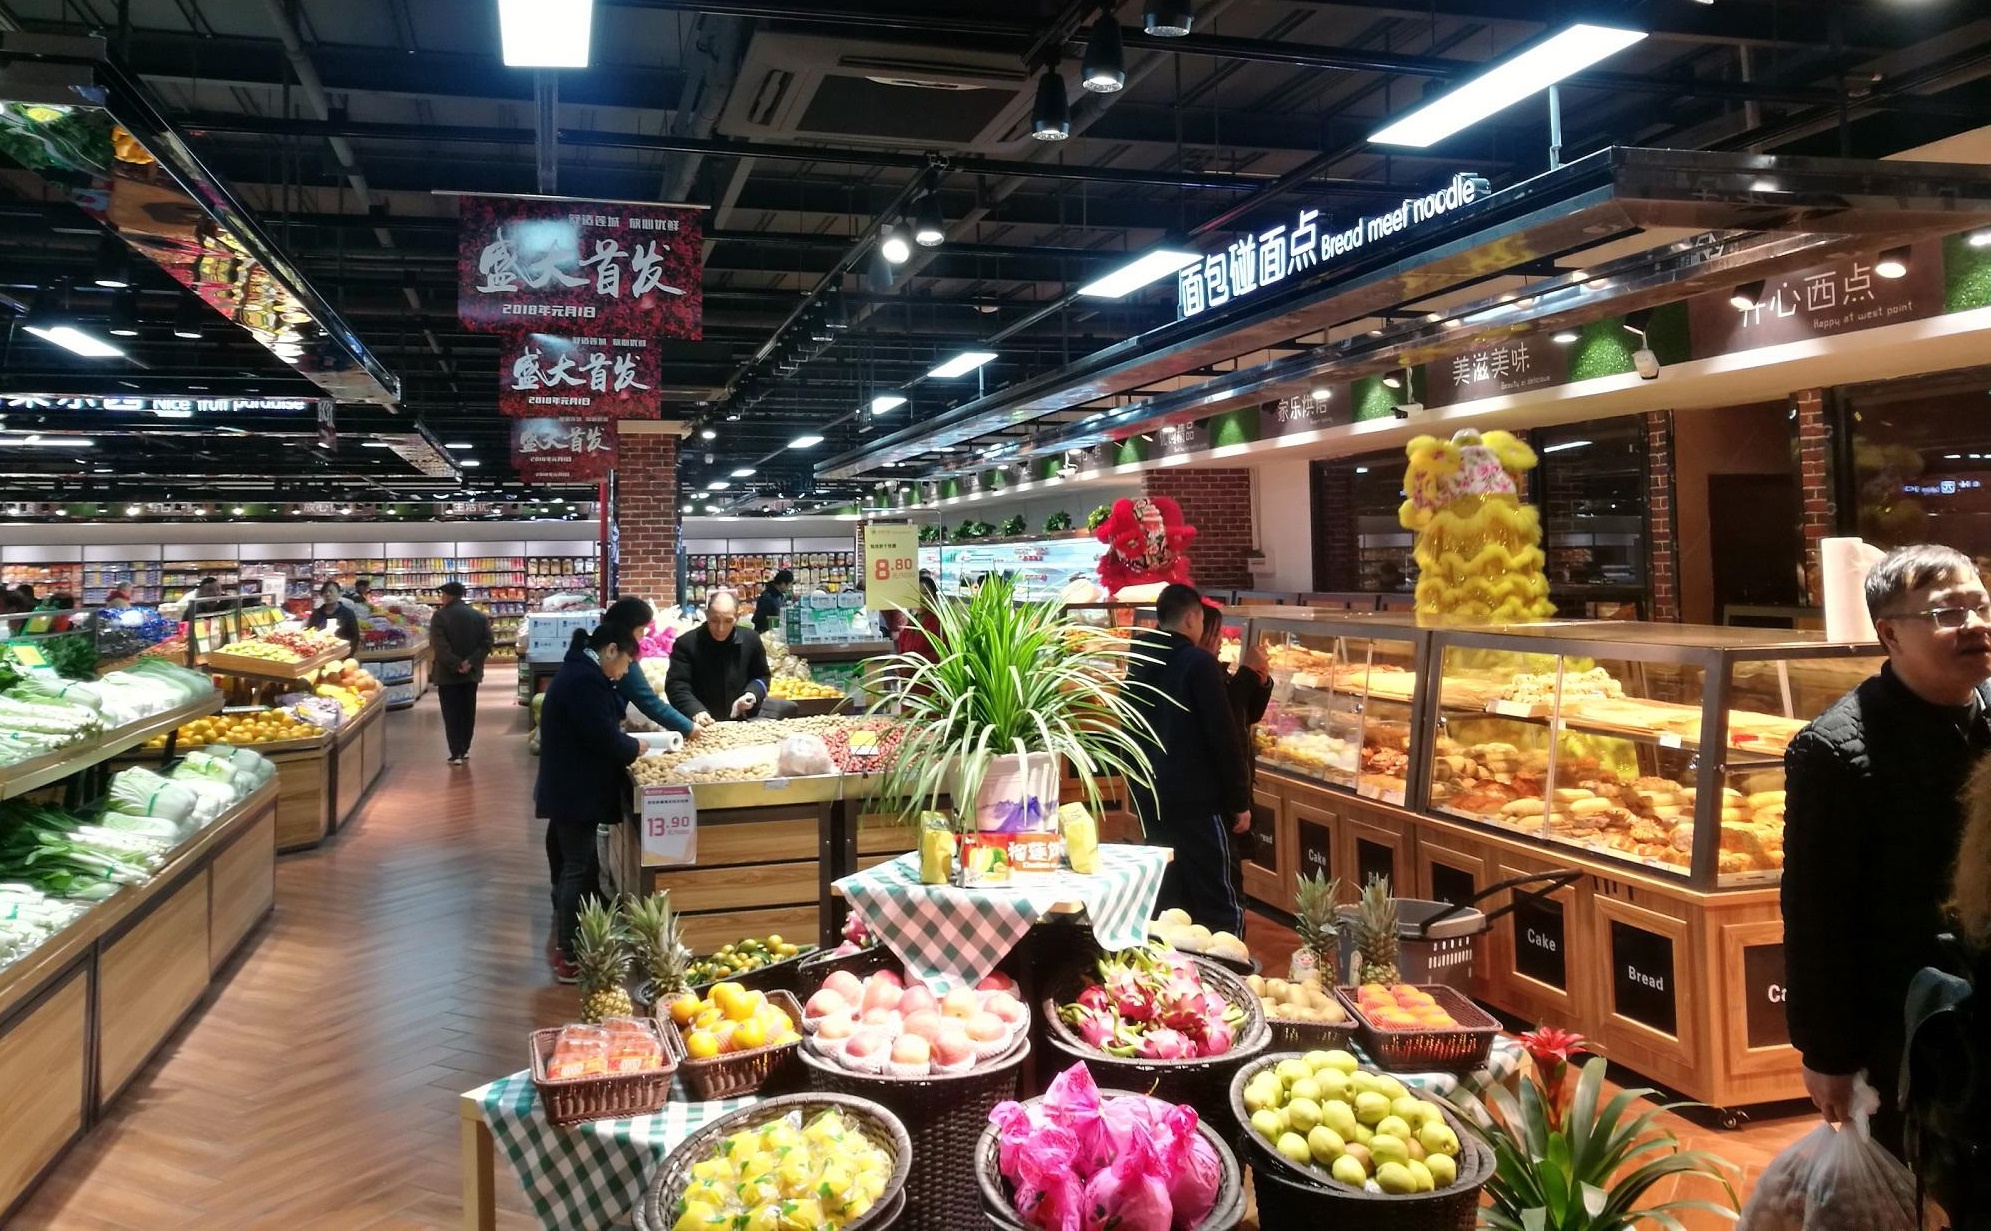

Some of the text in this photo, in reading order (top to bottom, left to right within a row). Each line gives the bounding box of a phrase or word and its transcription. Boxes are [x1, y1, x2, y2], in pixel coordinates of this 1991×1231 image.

[1321, 173, 1475, 262] Bread meet noodle
[476, 226, 687, 299] 盛大首发
[1180, 210, 1318, 317] 面包碰面点
[502, 303, 597, 319] 2018年元月1日
[1813, 316, 1841, 330] Happy
[1857, 307, 1882, 321] west
[1886, 301, 1913, 318] point
[511, 345, 651, 392] 盛大首发
[1452, 341, 1530, 387] 美滋美味
[875, 558, 912, 581] 8.80
[647, 816, 689, 837] 13.90
[1308, 849, 1327, 866] Cake
[1527, 928, 1556, 952] Cake
[1628, 965, 1664, 992] Bread
